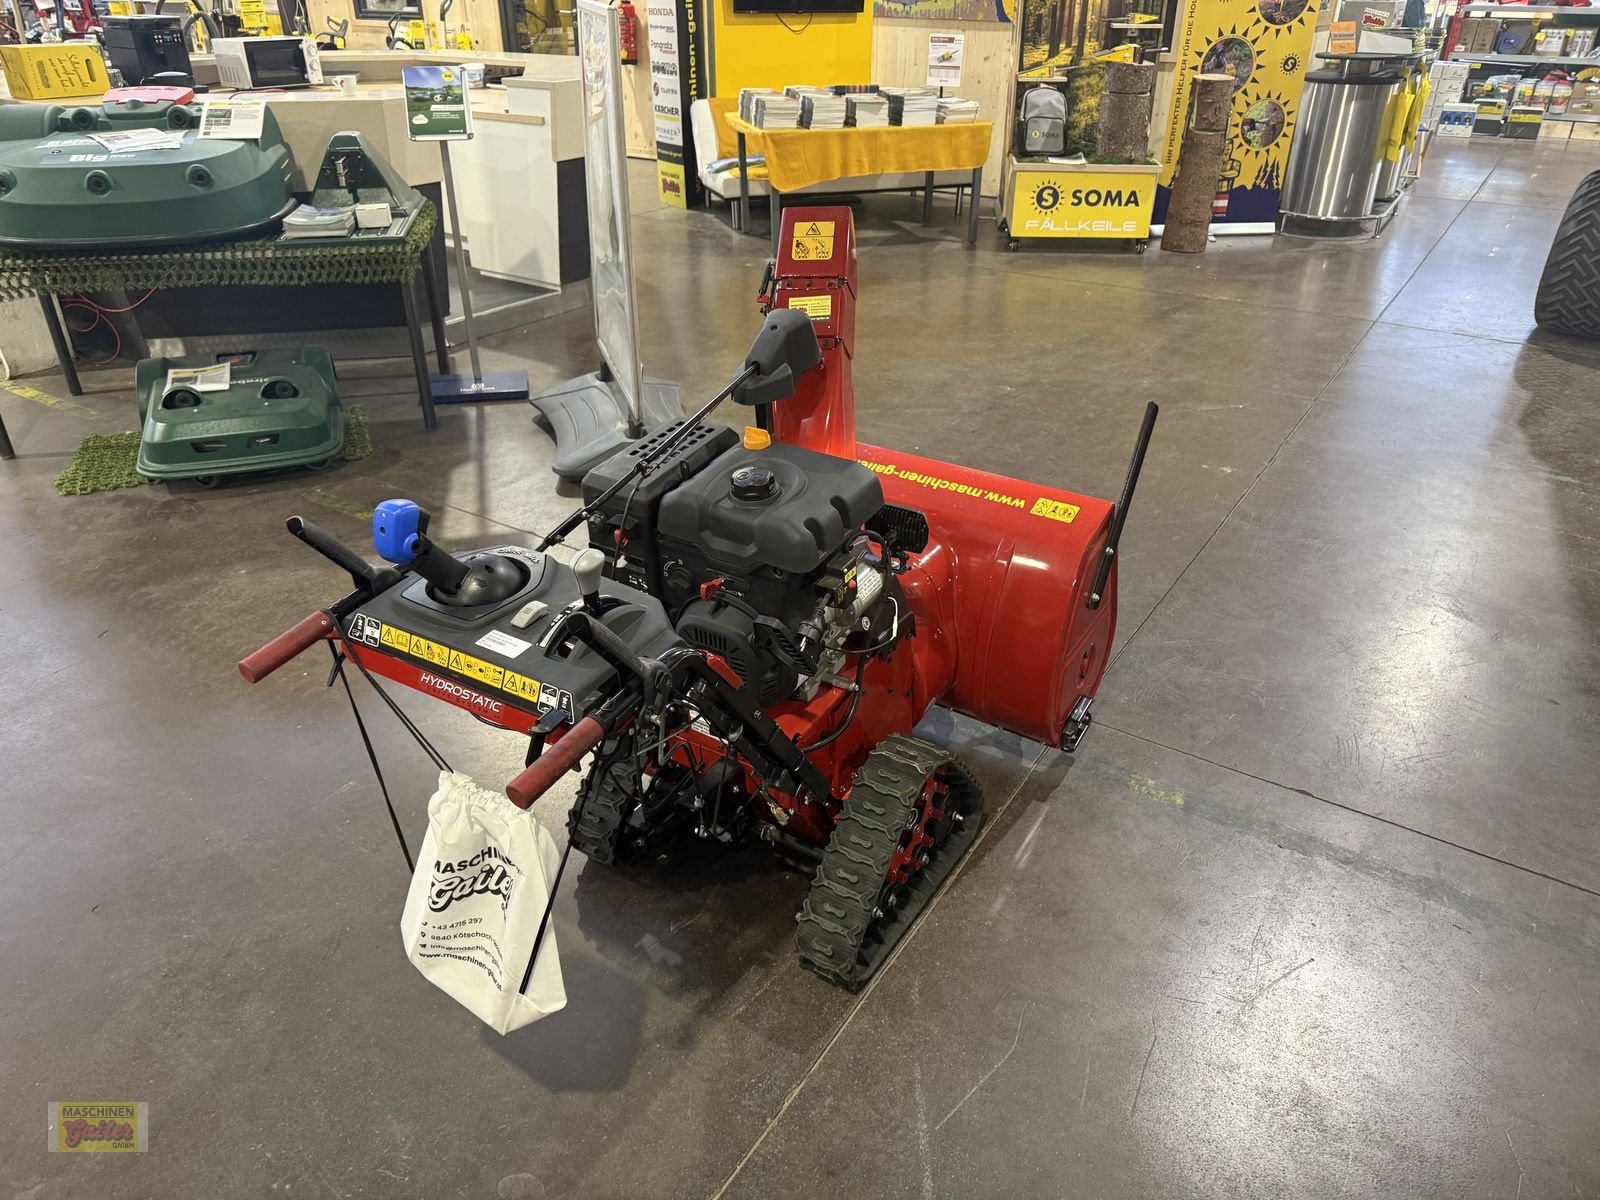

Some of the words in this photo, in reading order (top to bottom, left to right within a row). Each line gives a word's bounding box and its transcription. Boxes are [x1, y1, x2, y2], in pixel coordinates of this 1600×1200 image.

[648, 8, 674, 17] HONDA
[1186, 21, 1194, 36] DIE
[1183, 38, 1191, 57] FÜR
[1175, 60, 1187, 95] HELFER
[1070, 189, 1140, 207] SOMA
[1025, 218, 1137, 232] FÄLLKEILE
[420, 672, 502, 713] HYDROSTATIC
[427, 685, 451, 698] DRIVE
[456, 698, 488, 713] SYSTEM
[468, 917, 483, 925] 297
